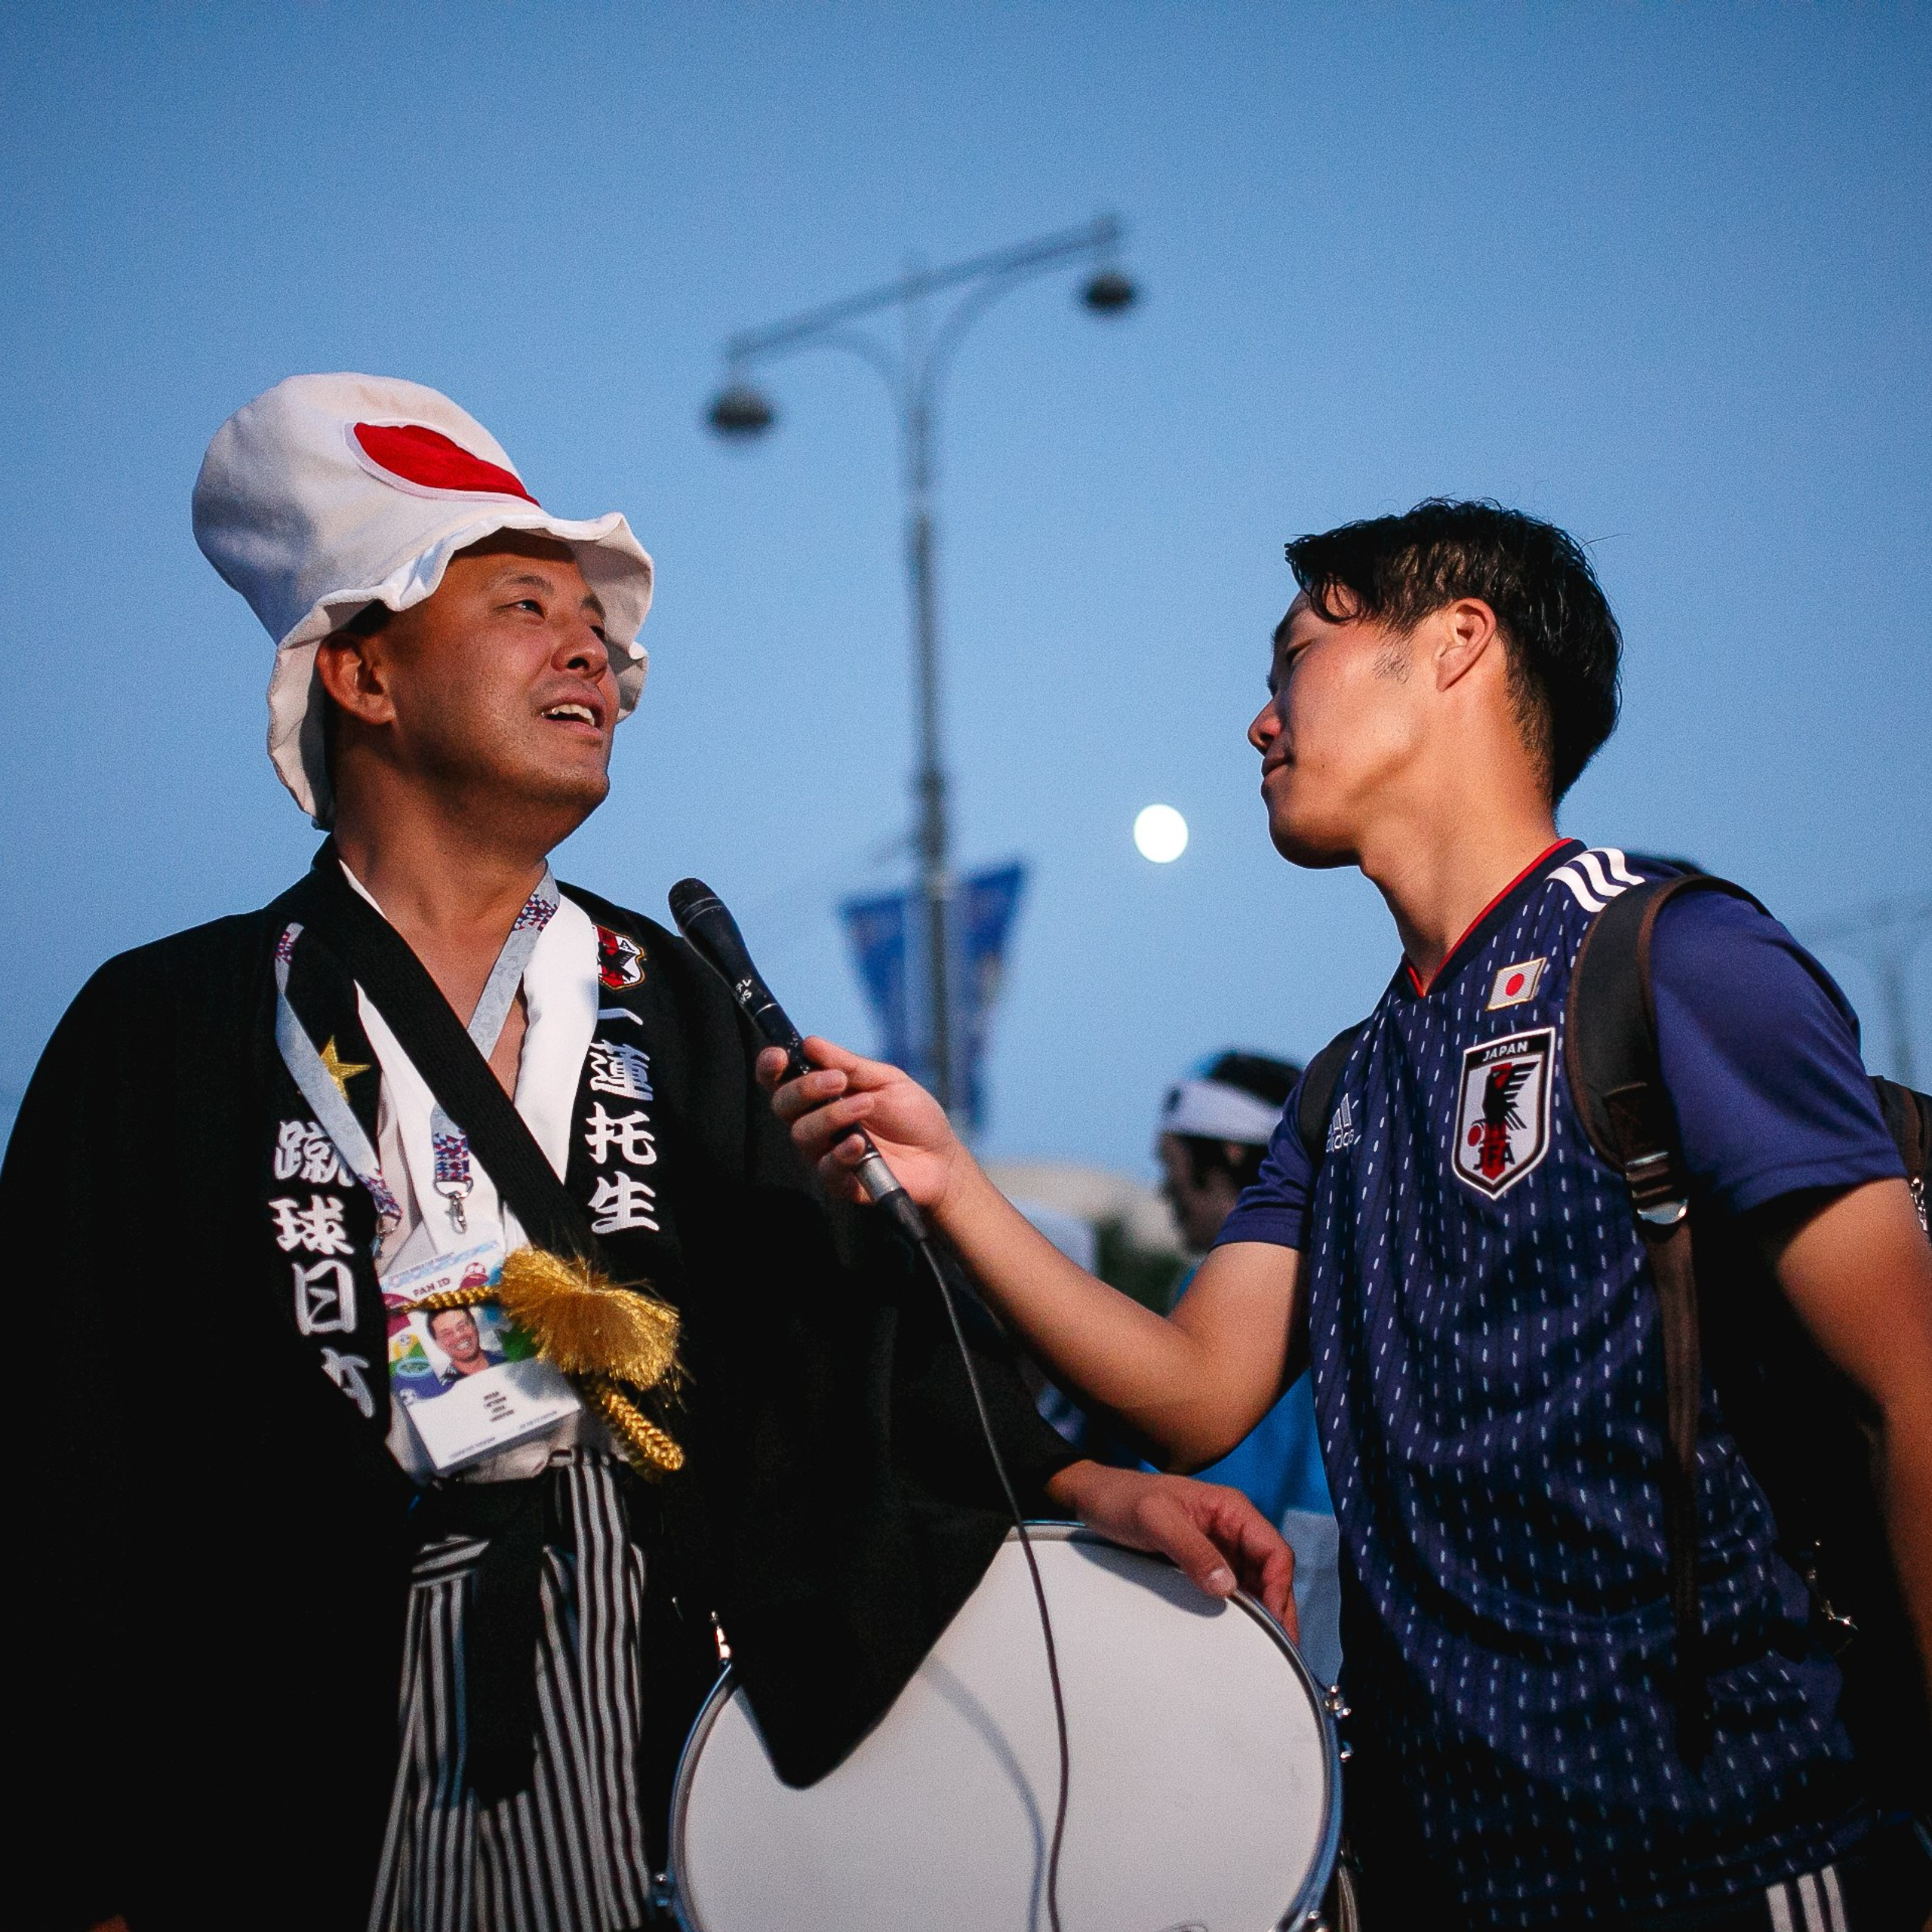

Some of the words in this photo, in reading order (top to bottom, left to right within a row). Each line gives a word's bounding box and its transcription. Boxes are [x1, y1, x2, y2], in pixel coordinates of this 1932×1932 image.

[1482, 1041, 1528, 1062] JAPAN
[584, 1008, 660, 1235] 一蓮托生
[1472, 1145, 1515, 1170] JFA
[412, 1282, 436, 1297] FAN
[437, 1277, 451, 1288] ID
